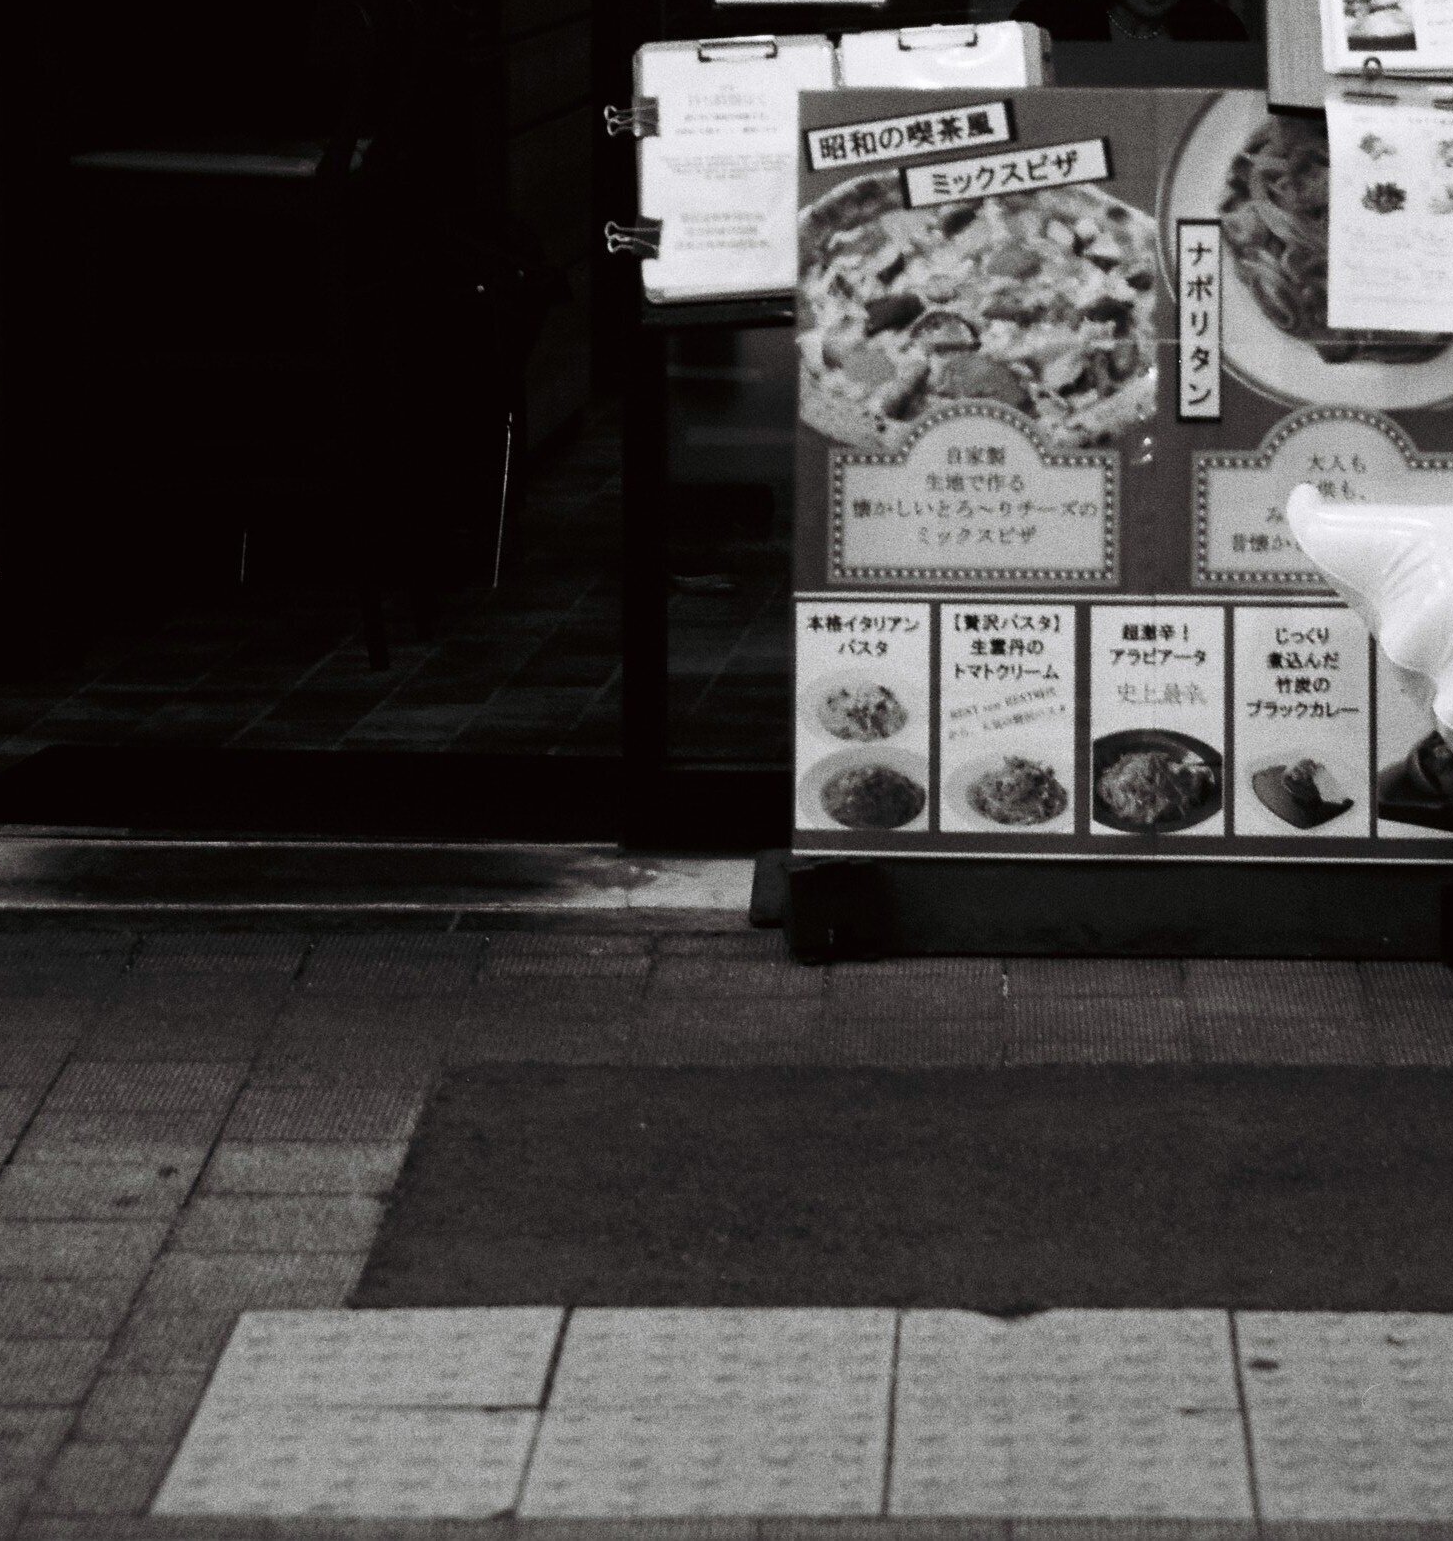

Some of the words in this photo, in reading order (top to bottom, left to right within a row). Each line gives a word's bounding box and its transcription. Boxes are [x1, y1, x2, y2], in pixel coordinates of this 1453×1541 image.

[817, 110, 995, 160] 昭和の喫茶風
[931, 149, 1079, 196] ミックスピザ
[1186, 241, 1214, 406] ナポリタン
[947, 445, 1005, 466] 自家製
[1309, 453, 1367, 475] 大人も
[925, 472, 1025, 493] 生地で作る
[806, 613, 921, 633] 本格イタリアン
[1274, 626, 1330, 646] じっくり
[837, 638, 889, 657] パスタ
[1109, 647, 1207, 667] アラビアータ
[954, 662, 1060, 680] トマトクリーム
[1267, 651, 1341, 671] 煮込んだ
[1275, 674, 1331, 695] 竹炭の
[1246, 699, 1360, 719] ブラックカレー
